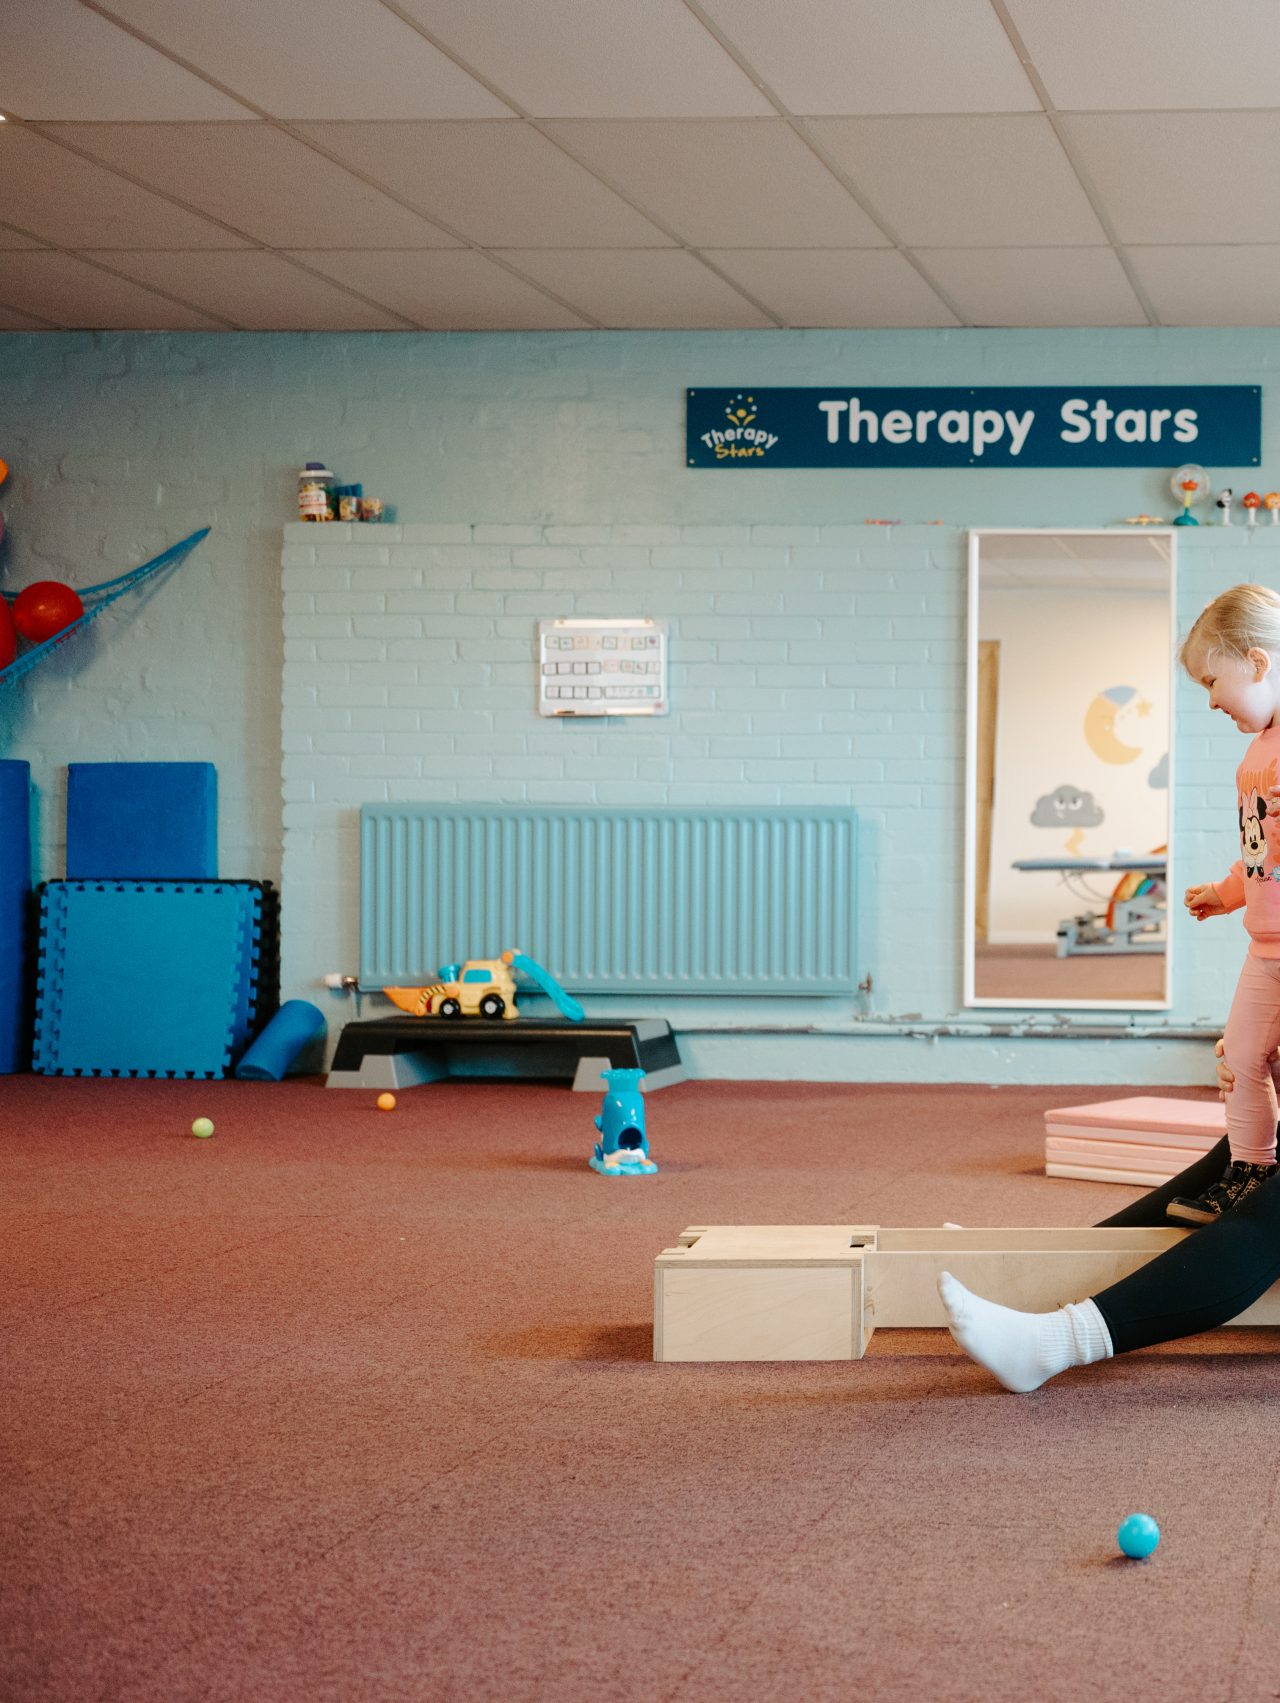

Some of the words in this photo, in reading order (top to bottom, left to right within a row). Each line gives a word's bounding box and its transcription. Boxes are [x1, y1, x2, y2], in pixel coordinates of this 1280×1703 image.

[700, 427, 779, 449] Therapy
[818, 398, 1035, 456] Therapy
[1060, 399, 1199, 443] Stars
[714, 443, 765, 459] Stars
